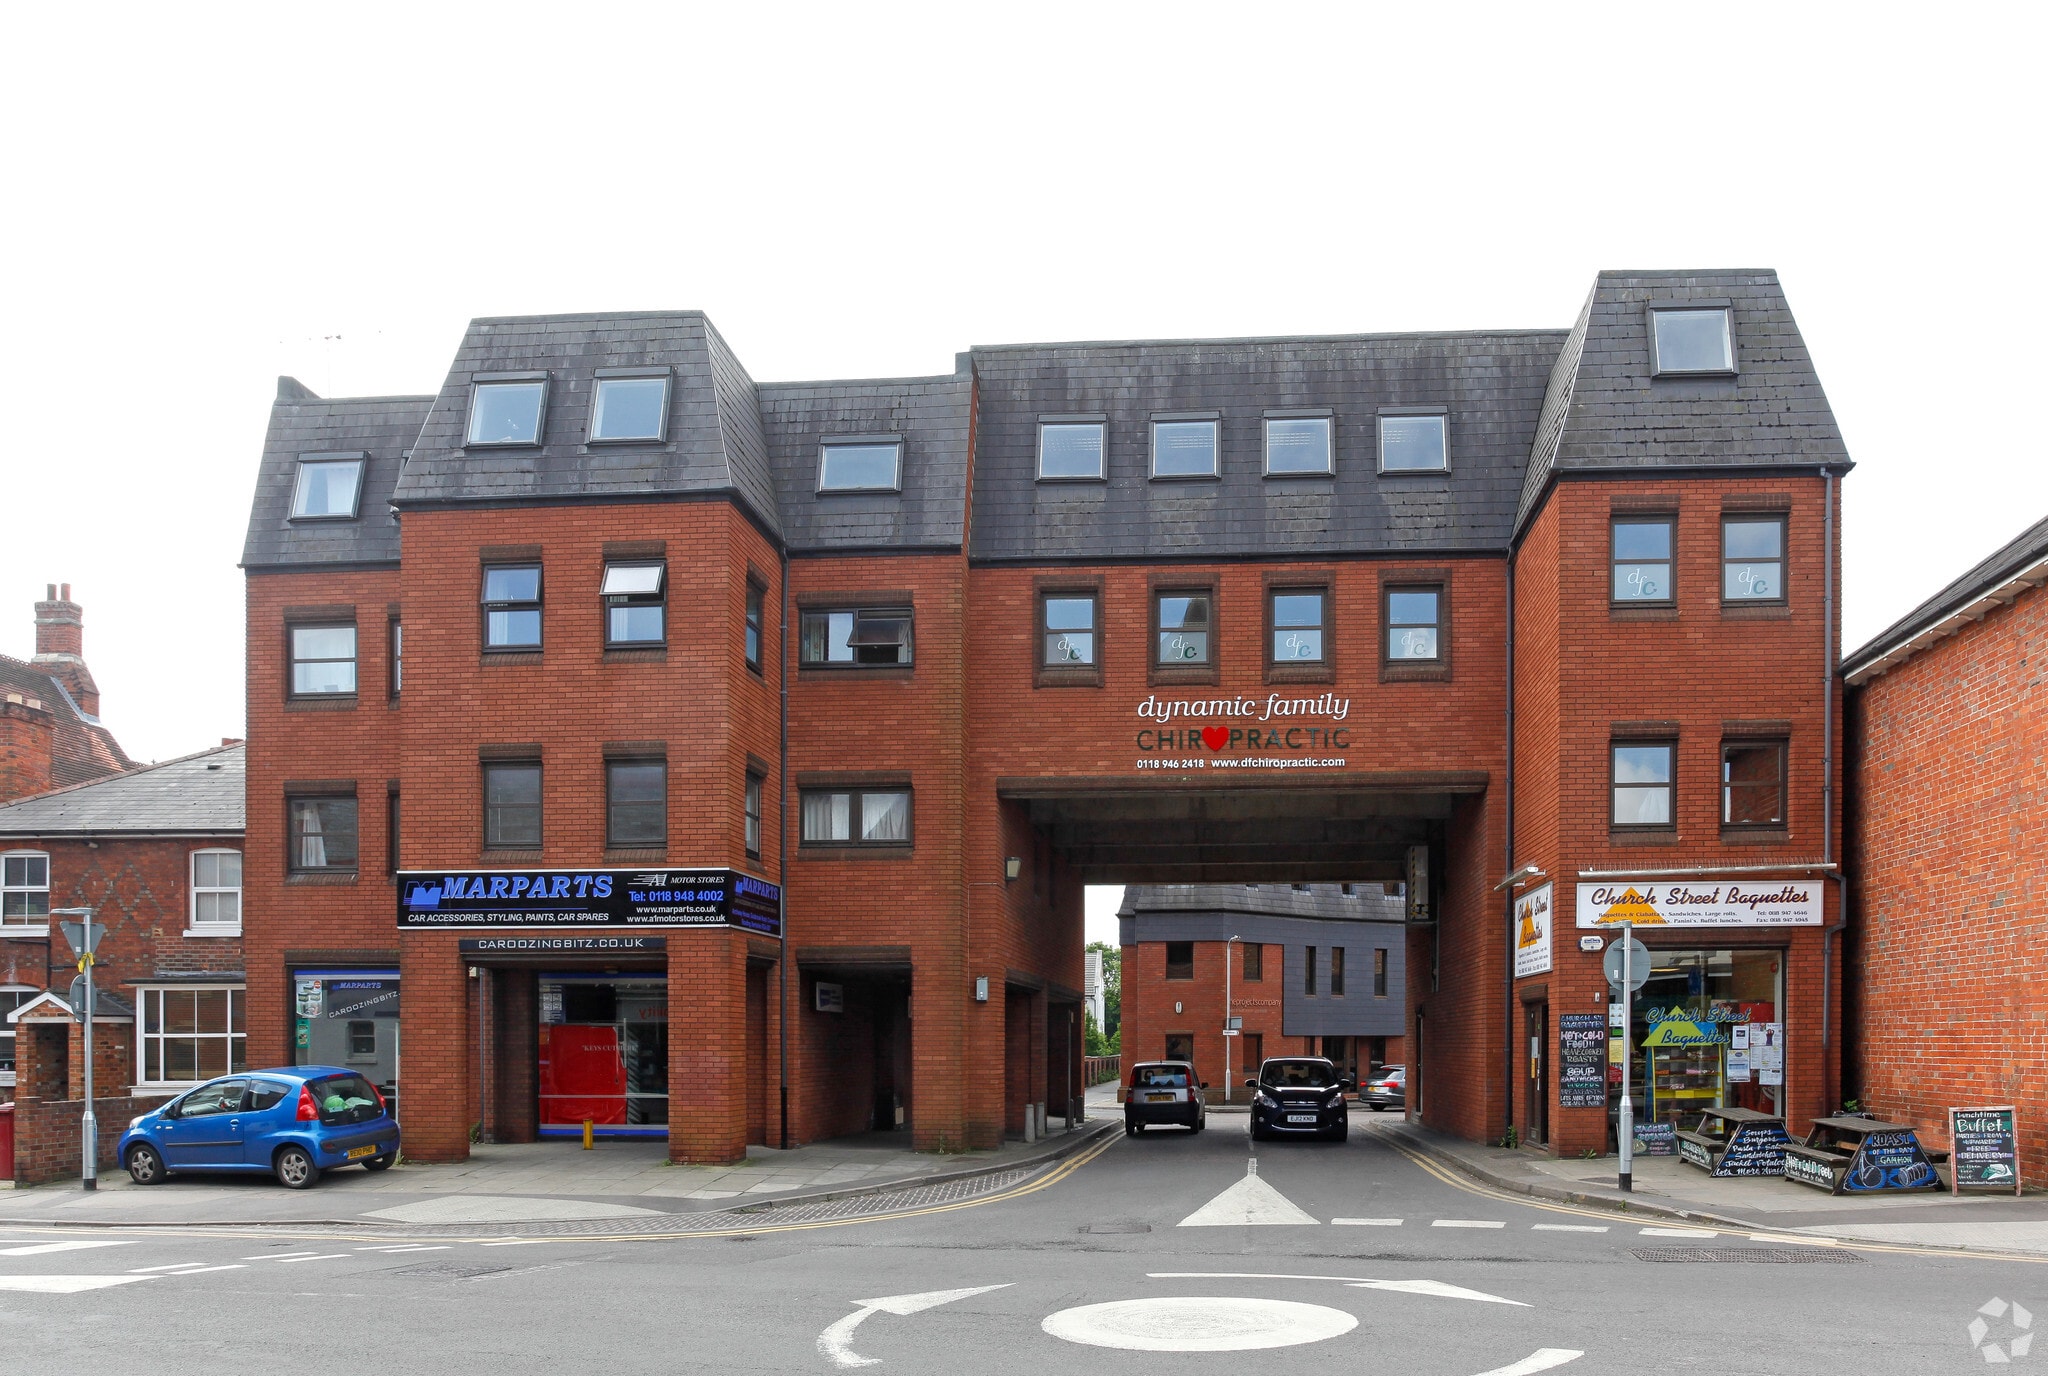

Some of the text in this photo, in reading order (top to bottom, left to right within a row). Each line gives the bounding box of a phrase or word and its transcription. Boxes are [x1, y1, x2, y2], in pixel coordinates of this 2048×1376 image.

[1137, 693, 1350, 723] dynamic family
[1137, 756, 1345, 769] 0118 946 2418 www.dfchiropractic.com
[671, 876, 696, 884] MOTOR
[697, 875, 725, 884] STORES
[441, 876, 613, 899] MARPARTS
[743, 876, 779, 901] MARPARTS
[629, 890, 724, 902] Tel: 0118 948 4002
[1591, 886, 1810, 910] Church Street Baguettes
[636, 904, 716, 914] www.marparts.co.uk
[408, 912, 609, 924] CAR ACCESSORIES, STYLING, PAINTS, CAR SPARES
[627, 913, 725, 923] www.a1motorstores.co.uk
[478, 938, 644, 949] CAROOZINGBITZ.CO.UK
[1645, 1006, 1752, 1023] Church Street
[1582, 1031, 1604, 1040] COLD
[1660, 1029, 1731, 1050] Baguettes
[1567, 1055, 1598, 1063] ROASTS
[1566, 1067, 1596, 1077] SOUP
[1871, 1132, 1911, 1147] ROAST
